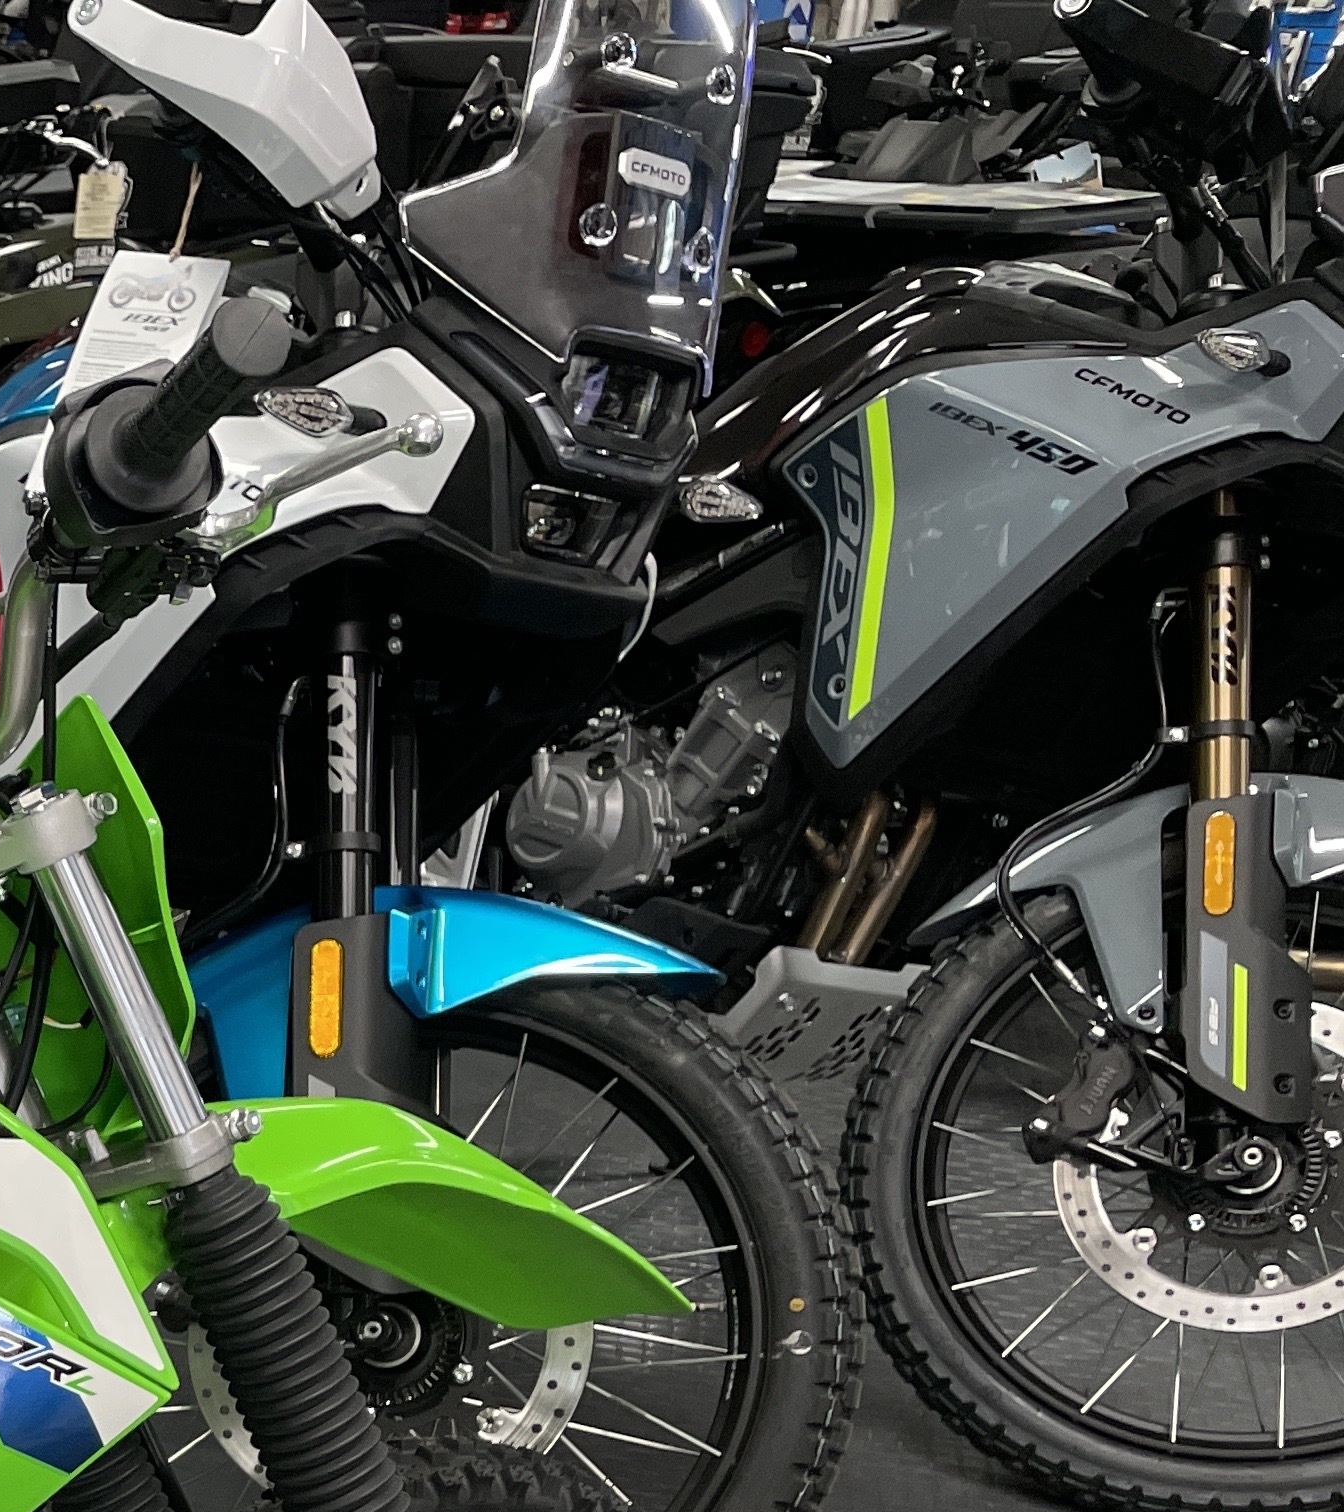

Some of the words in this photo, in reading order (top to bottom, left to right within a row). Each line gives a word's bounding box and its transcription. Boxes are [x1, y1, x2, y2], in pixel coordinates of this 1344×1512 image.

[630, 161, 688, 187] CFMOTO
[1074, 367, 1191, 425] CFMOTO
[928, 401, 1006, 436] IBEX
[1006, 429, 1099, 475] 450
[821, 440, 863, 665] IBEX
[327, 675, 357, 795] KYB
